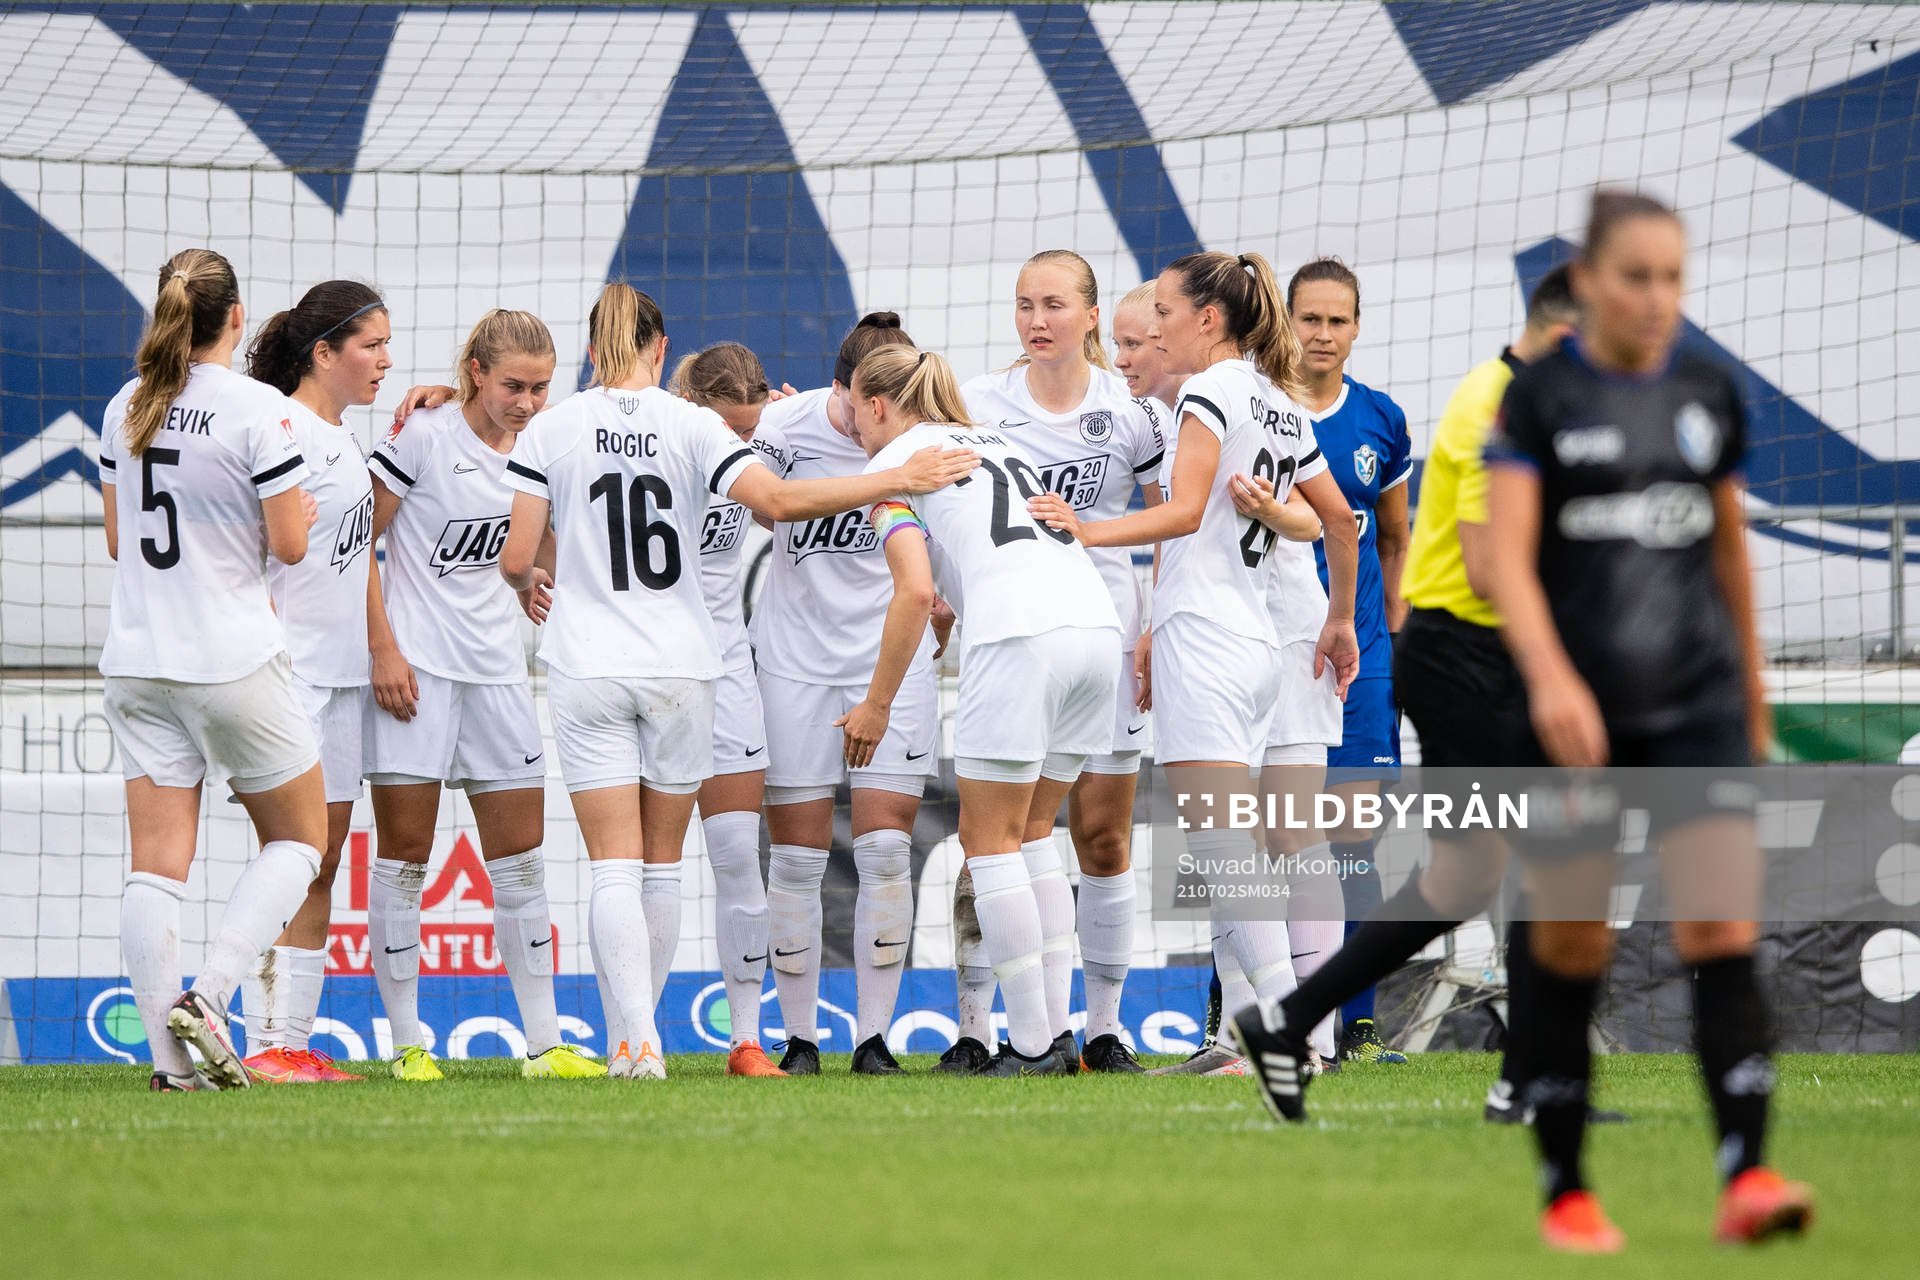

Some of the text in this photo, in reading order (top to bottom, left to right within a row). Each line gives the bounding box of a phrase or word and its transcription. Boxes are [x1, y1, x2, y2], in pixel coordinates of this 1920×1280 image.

[161, 407, 216, 436] EVIK
[596, 428, 658, 458] ROGIC
[949, 434, 1008, 447] PLAN
[1081, 461, 1101, 480] 20
[140, 446, 181, 570] 5
[1074, 487, 1095, 506] 30
[723, 505, 742, 525] 20
[440, 519, 511, 562] JAG
[589, 472, 682, 591] 16
[713, 532, 734, 549] 30
[793, 510, 863, 549] JAG
[854, 531, 876, 548] 30
